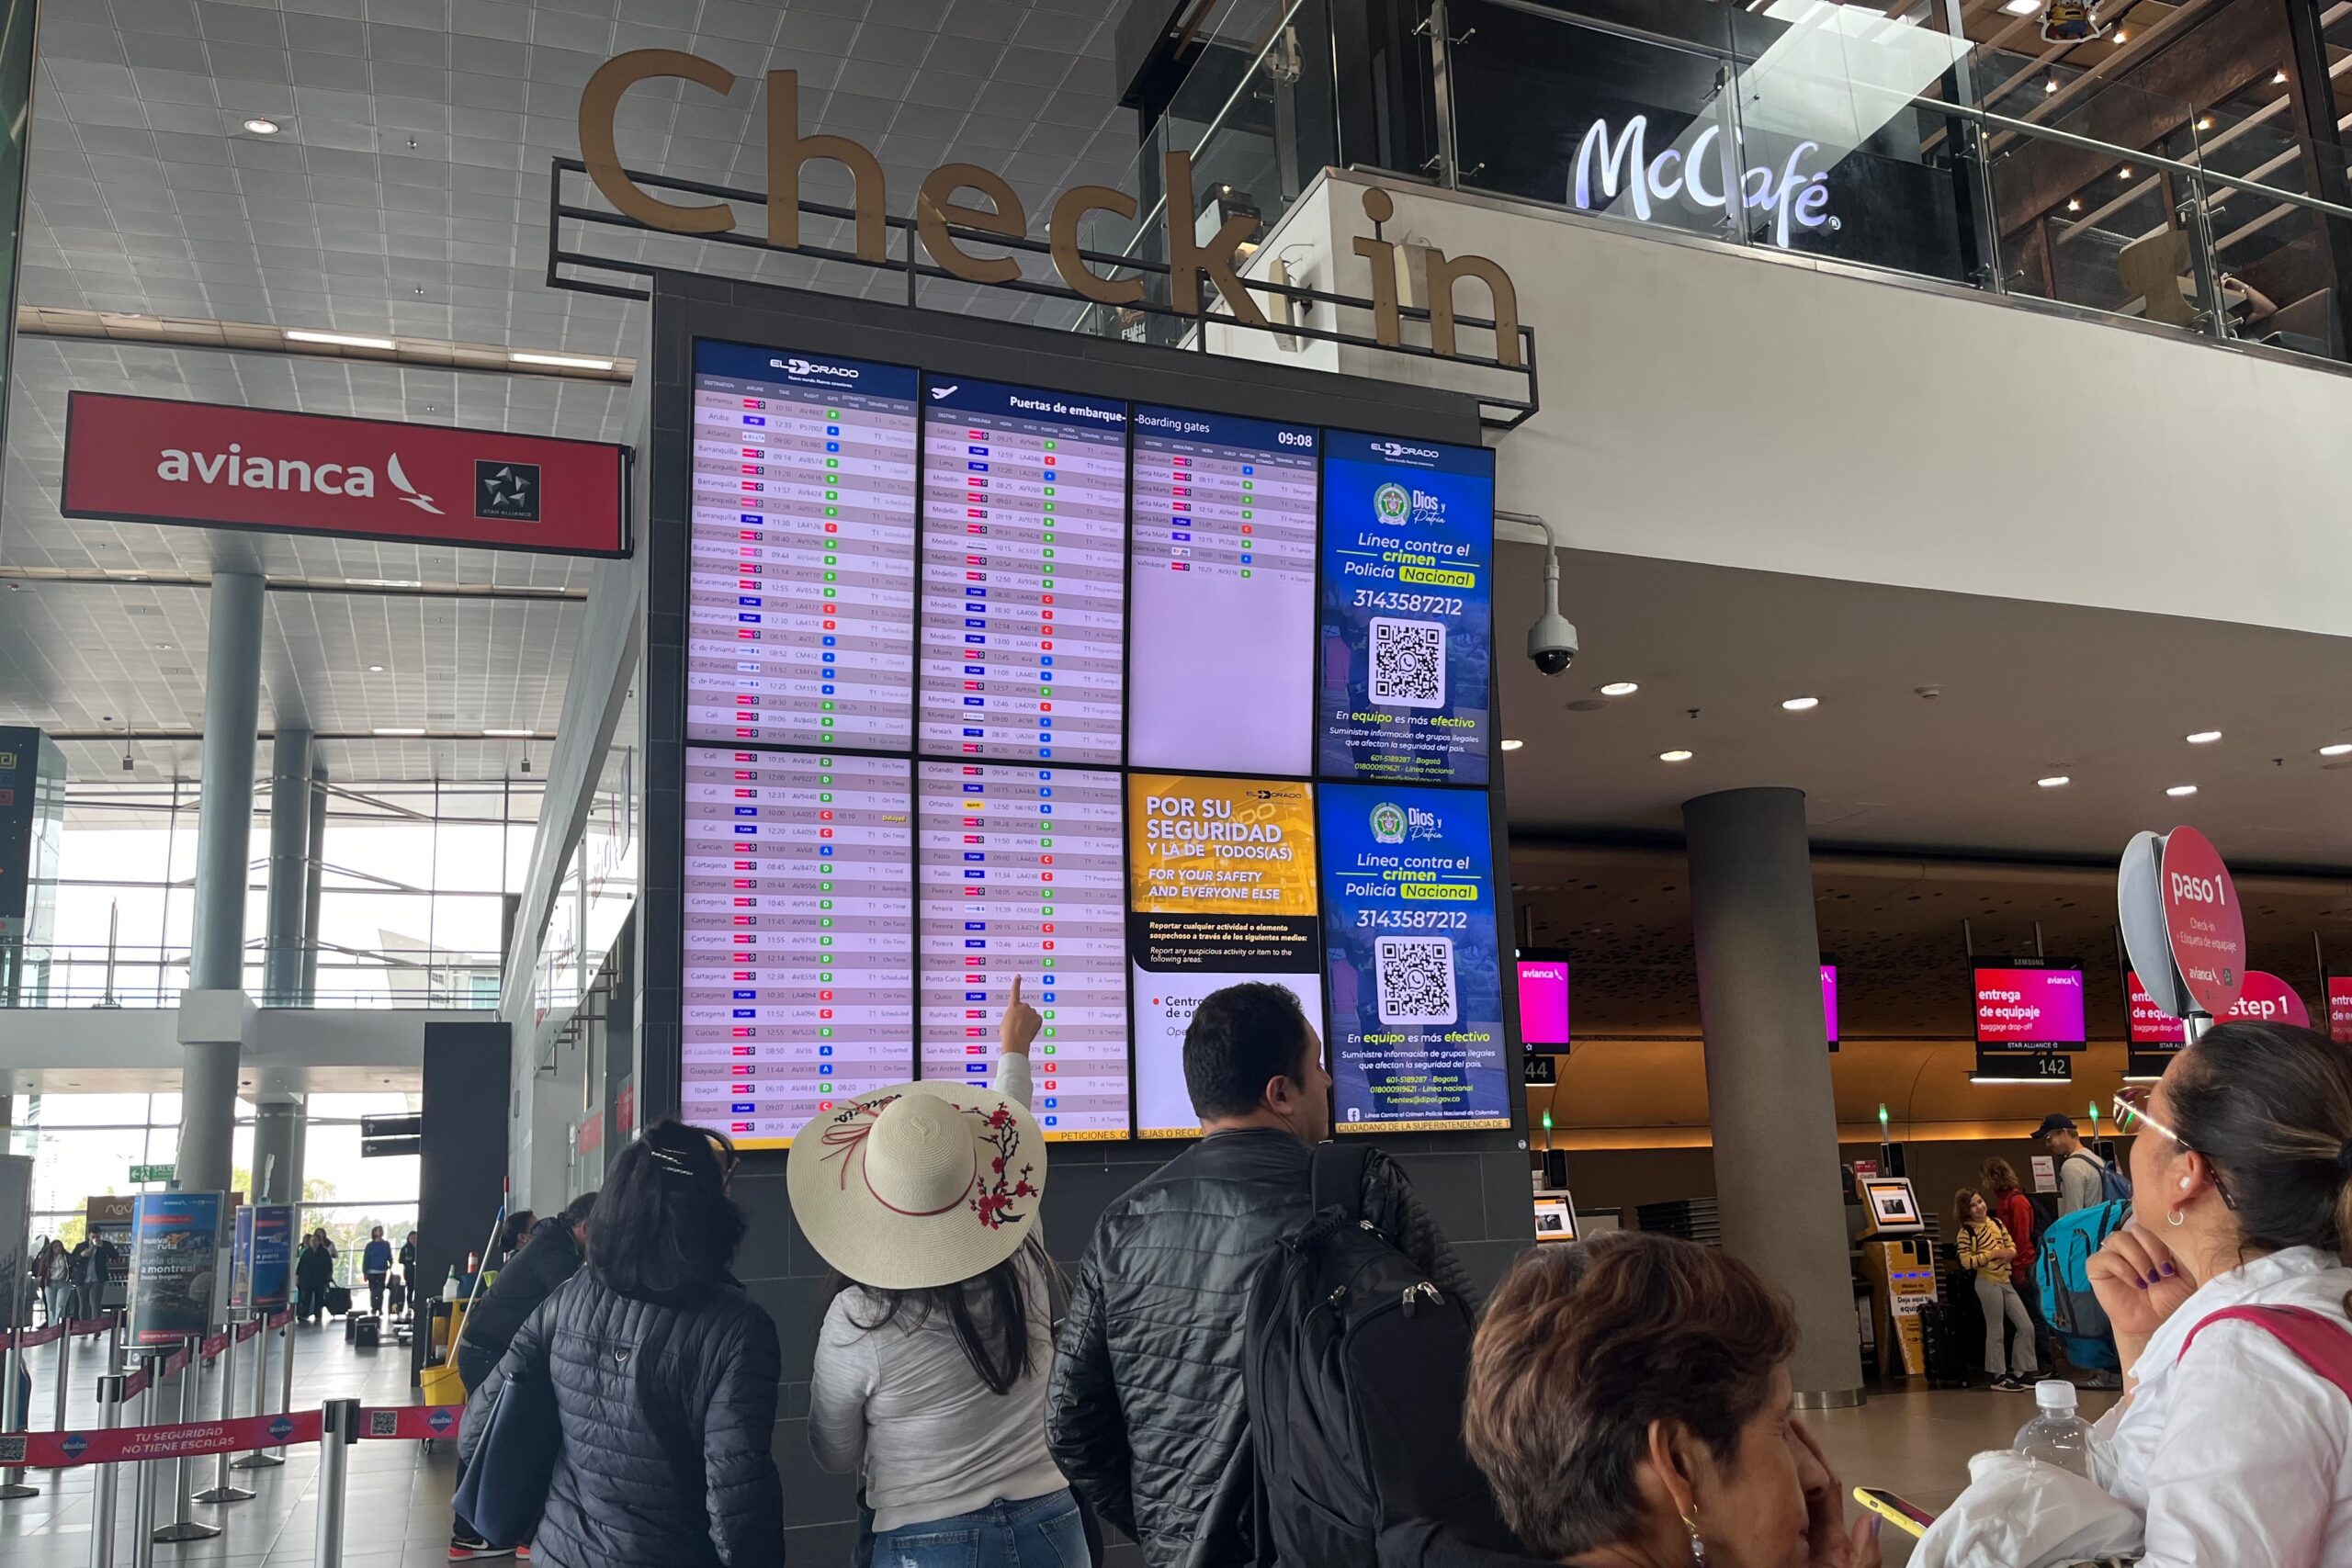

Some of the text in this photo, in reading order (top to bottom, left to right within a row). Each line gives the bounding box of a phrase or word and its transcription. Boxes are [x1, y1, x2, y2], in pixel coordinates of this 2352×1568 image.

[578, 48, 1520, 367] Check in
[1011, 397, 1050, 412] Puertas
[1054, 403, 1067, 413] de
[1184, 423, 1210, 434] gates
[1278, 432, 1312, 446] 09:08
[157, 443, 374, 498] avianca
[1413, 490, 1445, 513] Dios y
[1413, 509, 1446, 526] Patria
[1358, 533, 1470, 557] Línea contra el
[1383, 549, 1436, 566] crimen
[1344, 562, 1469, 586] Policía Nacional
[1353, 589, 1463, 615] 3143587212
[1336, 711, 1349, 720] En
[1351, 712, 1392, 725] equipo
[1408, 714, 1428, 725] más
[1430, 715, 1476, 728] efectivo
[1147, 796, 1231, 818] POR SU
[1408, 807, 1442, 829] Dios y
[1148, 819, 1282, 842] SEGURIDAD
[1409, 827, 1443, 841] Patria
[1148, 842, 1292, 862] Y LA DE TODOS(AS)
[1357, 853, 1469, 870] Línea contra el
[1148, 869, 1262, 883] FOR YOUR SAFETY
[1383, 867, 1437, 882] crimen
[1148, 886, 1280, 899] AND EVERYONE ELSE
[1346, 883, 1472, 898] Policía Nacional
[2171, 872, 2225, 906] paso 1
[1149, 922, 1182, 931] Reportar
[1183, 923, 1215, 932] cualquier
[1357, 910, 1467, 929] 3143587212
[2190, 917, 2215, 932] Check-in
[1149, 932, 1191, 941] sospechoso
[1245, 933, 1280, 942] siguientes
[2180, 931, 2236, 953] Etiqueta de equipaje
[1150, 947, 1173, 955] Report
[1224, 948, 1247, 956] activity
[1151, 955, 1181, 964] following
[1522, 968, 1554, 979] avianca
[2047, 976, 2071, 985] avianca
[2189, 966, 2212, 981] avianca
[1979, 989, 2020, 1003] entrega
[1980, 1005, 2040, 1020] de equipaje
[2228, 996, 2288, 1019] step 1
[1981, 1023, 2032, 1032] baggage drop-off
[1348, 1031, 1490, 1047] En equipo es más efectivo
[1441, 1051, 1466, 1060] grupos
[1468, 1049, 1495, 1059] ilegales
[1359, 1062, 1374, 1070] que
[1375, 1061, 1404, 1069] afectan
[1415, 1060, 1451, 1070] seguridad
[1524, 1062, 1547, 1078] 44
[2040, 1059, 2065, 1074] 142
[1433, 1075, 1458, 1084] Bogotá
[1339, 1123, 1386, 1132] CIUDADANO
[1389, 1122, 1399, 1131] DE
[1414, 1121, 1491, 1130] SUPERINTENDENCIA
[1061, 1132, 1115, 1140] PETICIONES,
[135, 1427, 223, 1442] TU SEGURIDAD
[121, 1437, 235, 1455] NO TIENE ESCALAS
